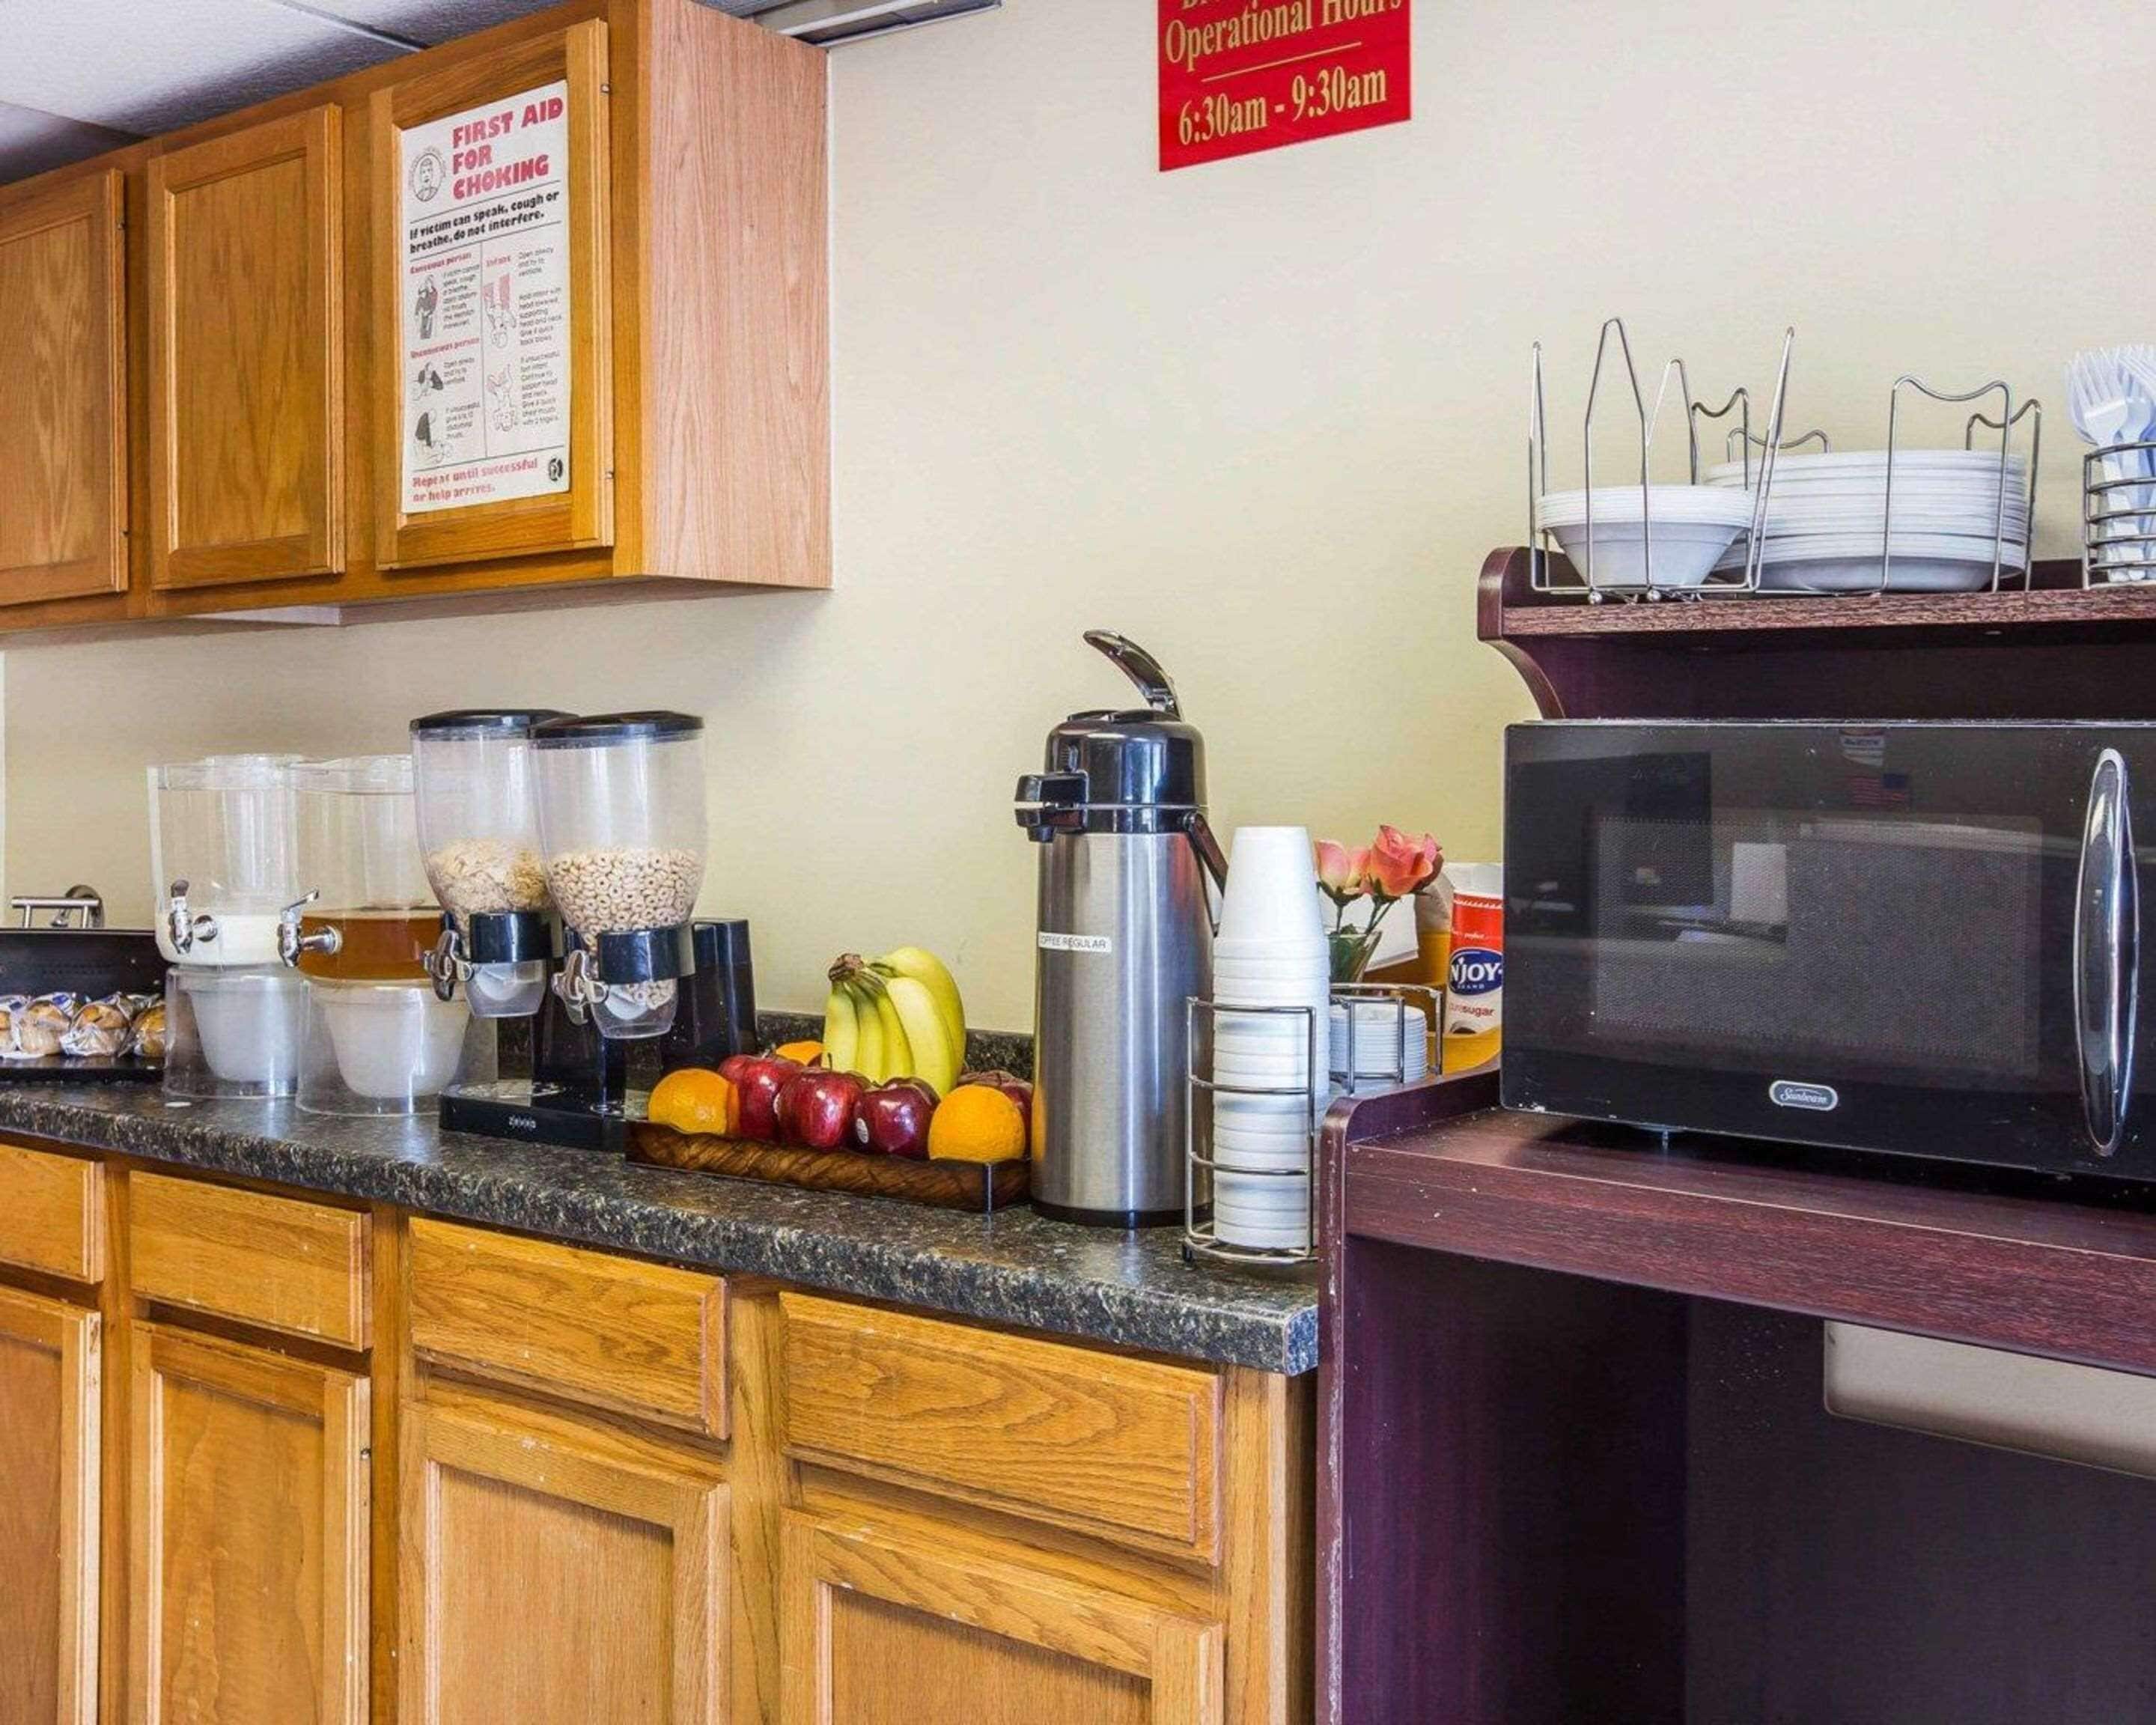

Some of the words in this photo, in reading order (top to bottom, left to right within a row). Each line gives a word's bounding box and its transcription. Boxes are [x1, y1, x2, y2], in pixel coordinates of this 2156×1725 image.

[1166, 0, 1312, 73] Operational
[452, 110, 514, 149] FIRST
[521, 97, 564, 128] AID
[1178, 93, 1267, 146] 6:30am
[1291, 65, 1386, 122] 9:30am
[452, 144, 493, 174] FOR
[452, 154, 549, 200] CHOKING
[409, 228, 418, 240] If
[420, 219, 451, 237] victim
[452, 215, 471, 228] can
[511, 195, 543, 212] cough
[546, 191, 560, 201] or
[454, 228, 466, 241] do
[467, 225, 486, 237] not
[489, 209, 544, 231] interfere.
[453, 468, 479, 480] until
[481, 458, 538, 475] successful
[412, 493, 425, 502] or
[428, 488, 451, 501] help
